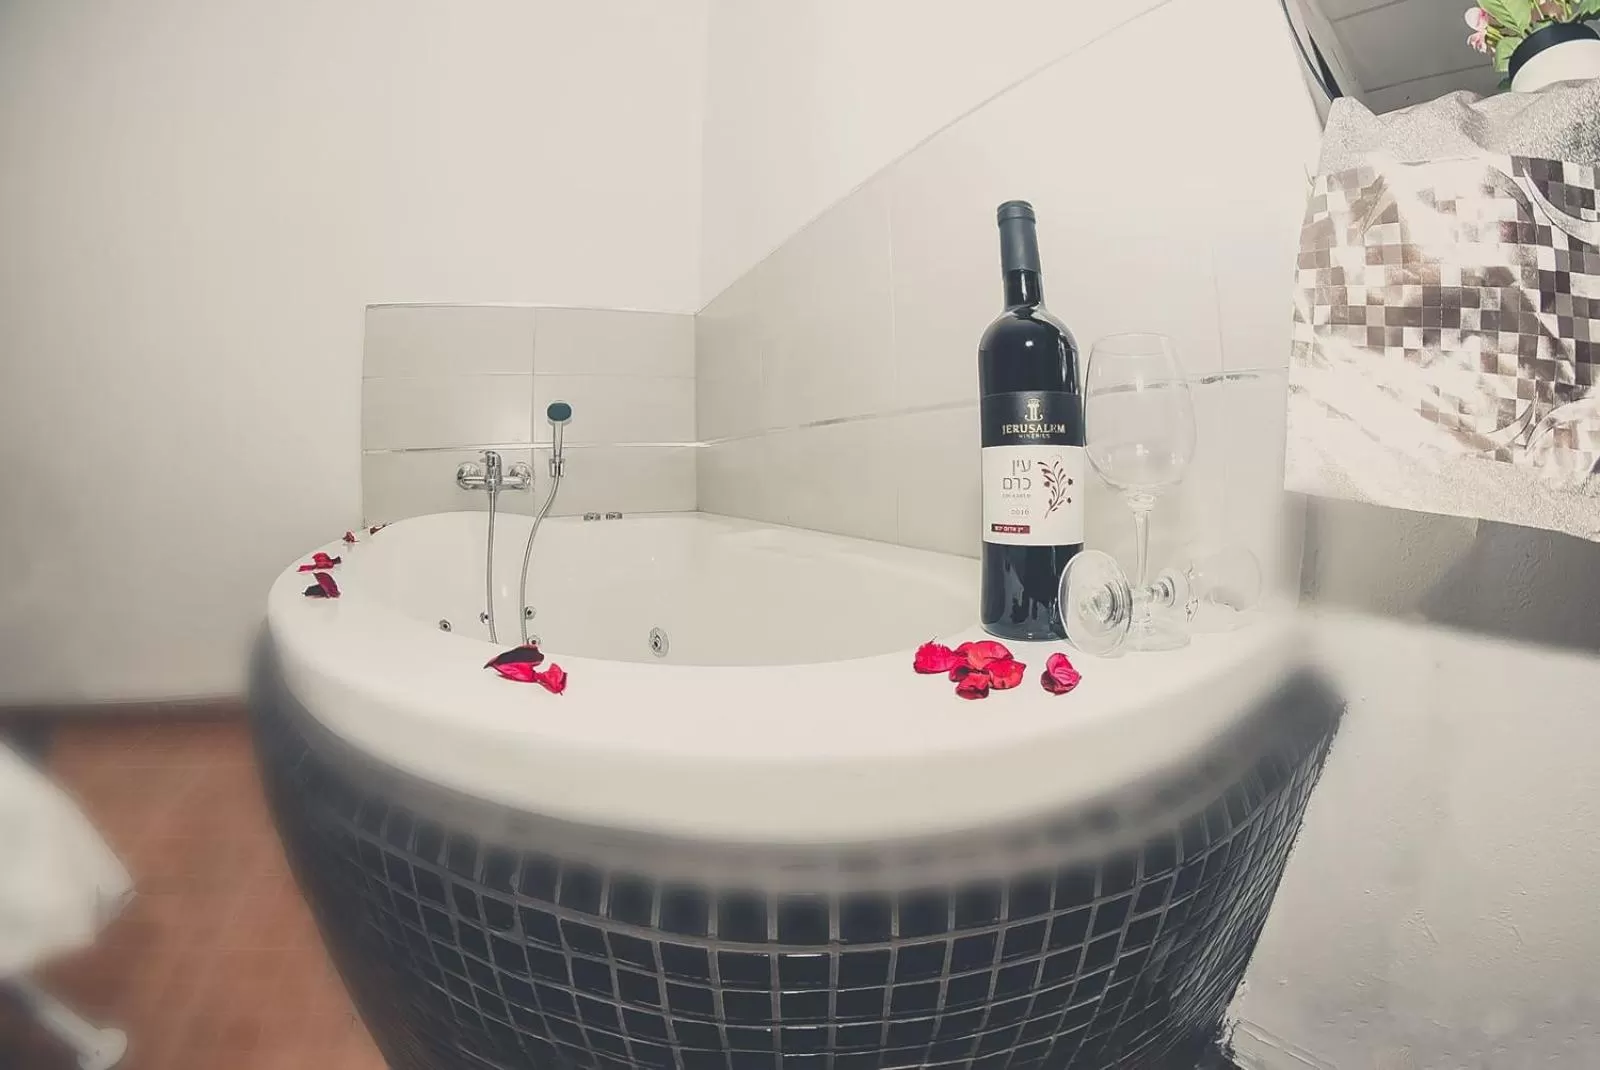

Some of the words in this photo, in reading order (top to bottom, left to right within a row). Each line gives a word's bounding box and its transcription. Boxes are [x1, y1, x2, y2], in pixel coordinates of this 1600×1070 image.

[1002, 424, 1066, 435] JERUSALEM
[1012, 460, 1032, 476] עין
[1003, 477, 1032, 490] כרם
